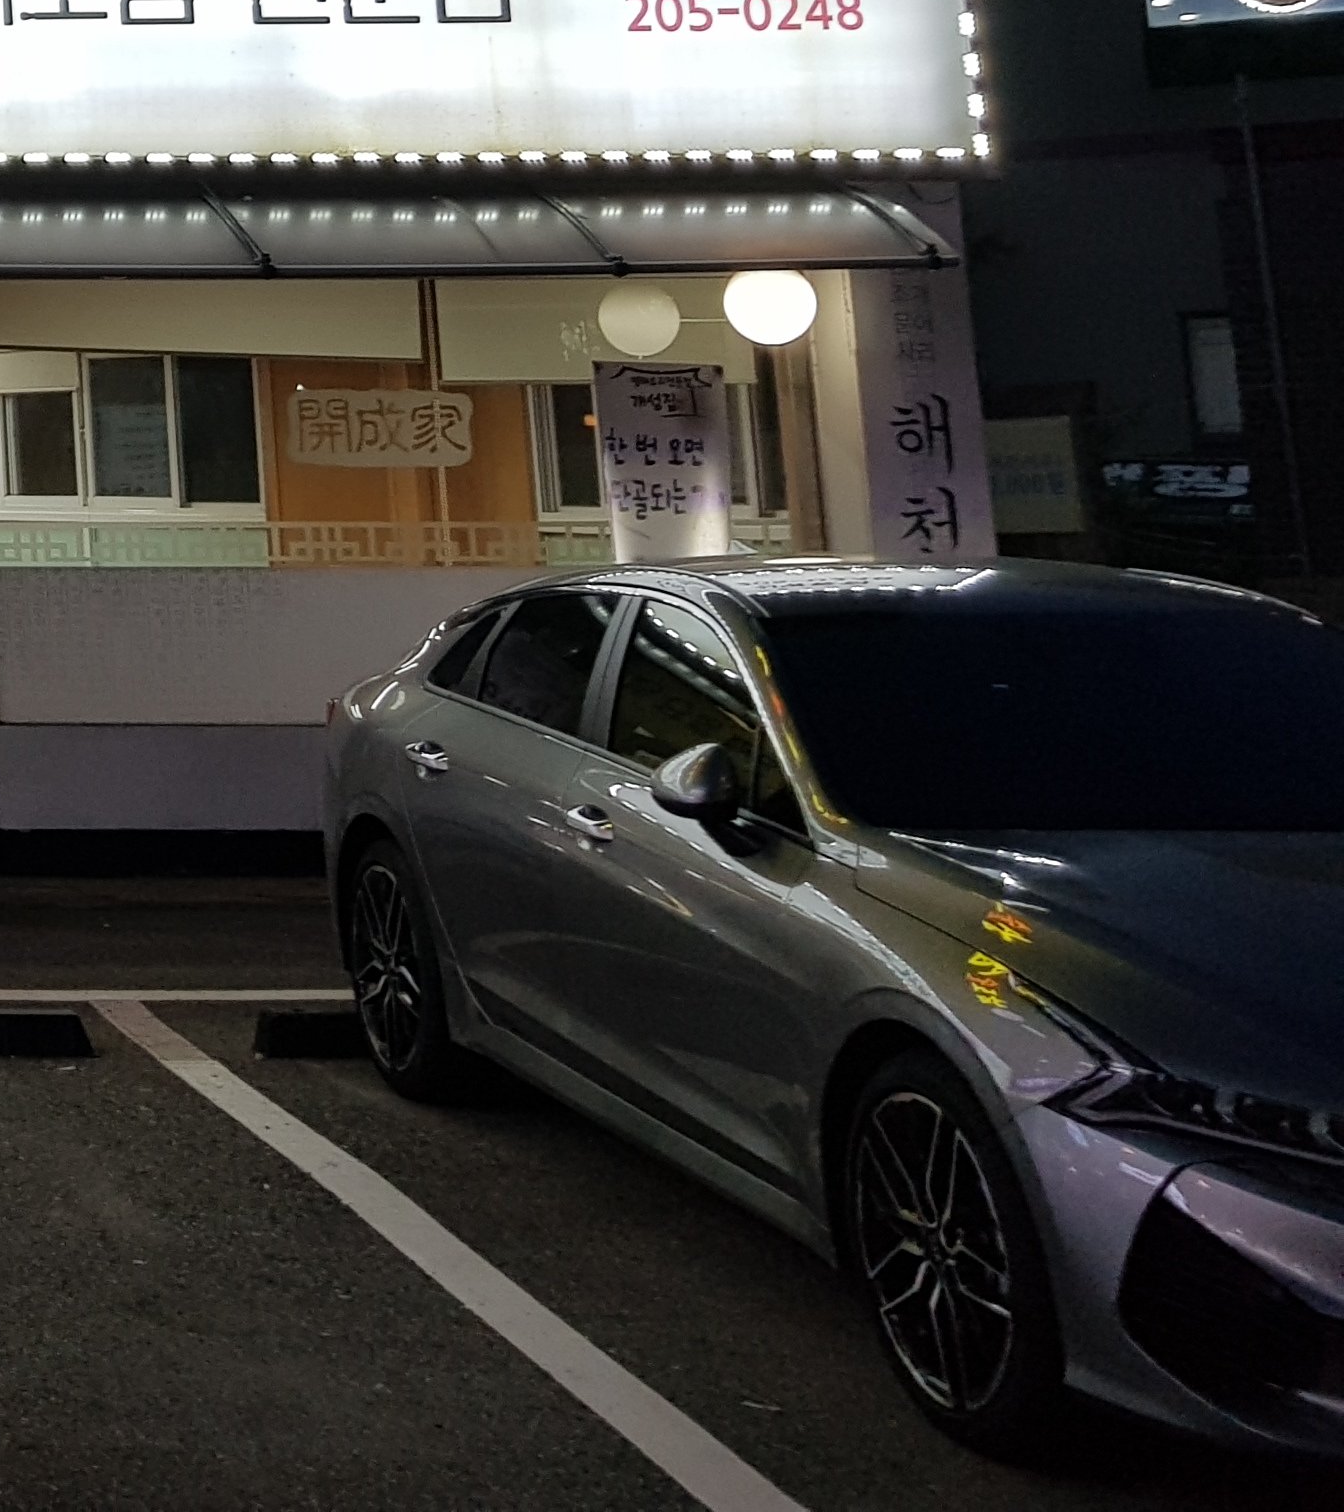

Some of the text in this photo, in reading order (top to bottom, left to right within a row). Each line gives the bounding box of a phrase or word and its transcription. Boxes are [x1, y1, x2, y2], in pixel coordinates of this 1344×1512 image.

[295, 397, 468, 454] 開成家
[606, 427, 705, 466] 한 번 오면
